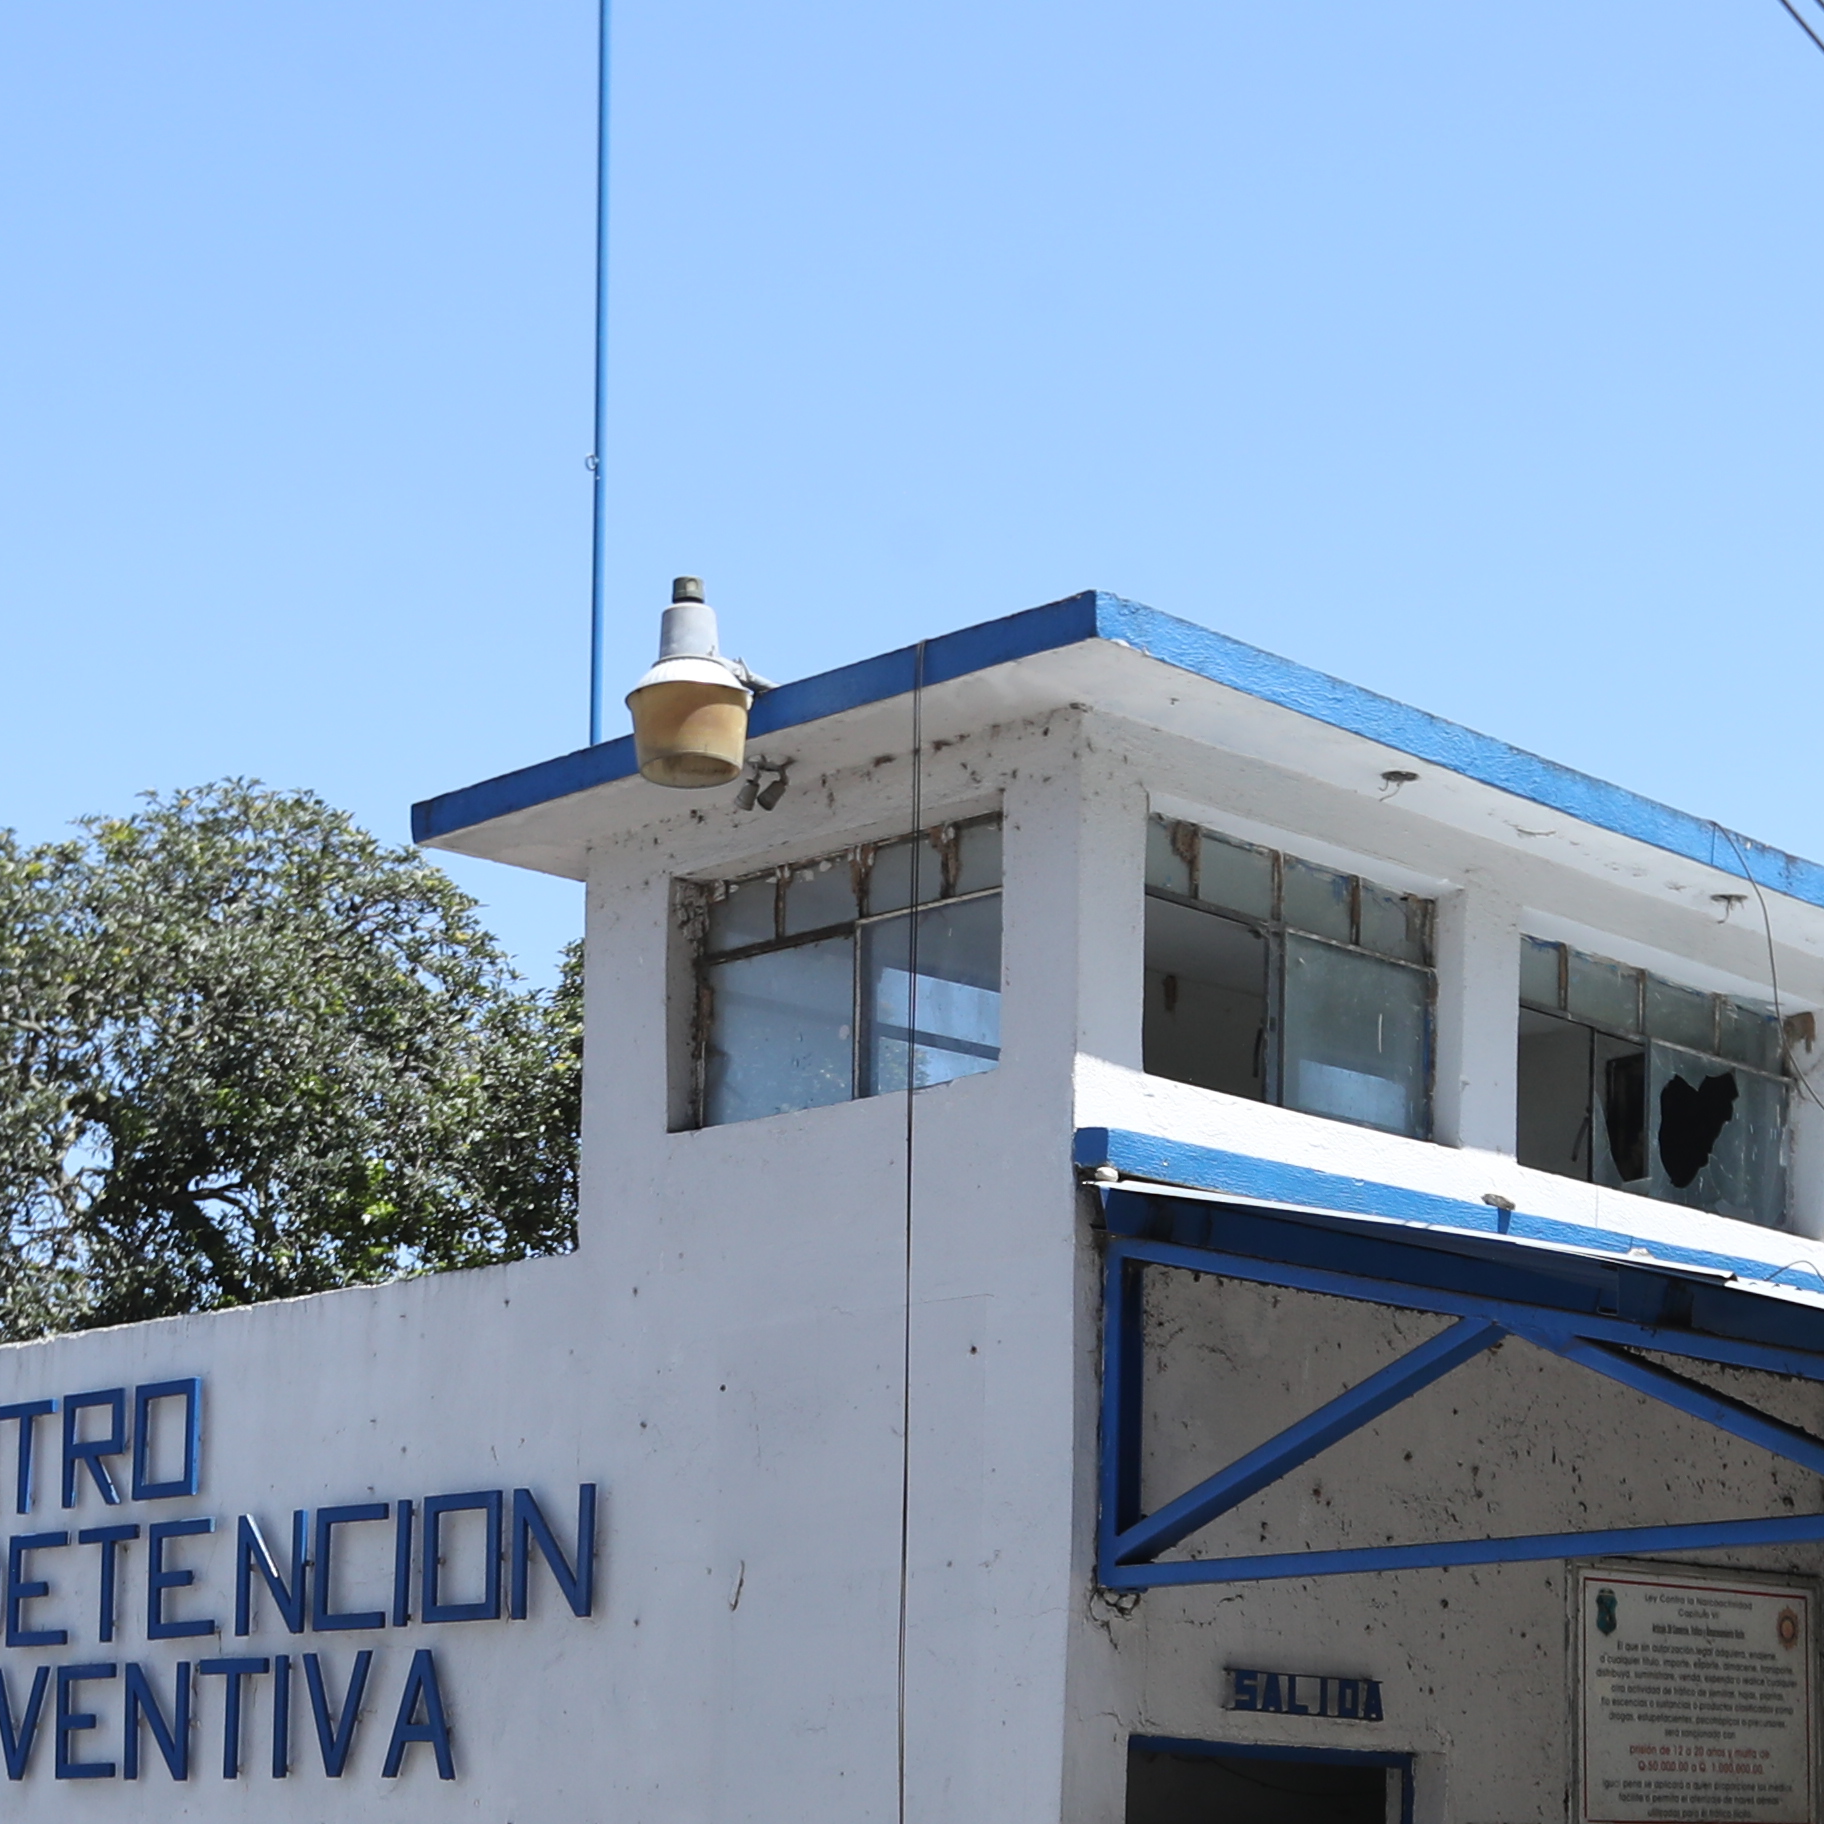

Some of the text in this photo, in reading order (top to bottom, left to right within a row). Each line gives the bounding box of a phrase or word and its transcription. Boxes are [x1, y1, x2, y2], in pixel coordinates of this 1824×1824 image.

[1232, 1669, 1384, 1721] SALIDA
[1659, 1746, 1671, 1756] de
[1693, 1746, 1704, 1757] 20
